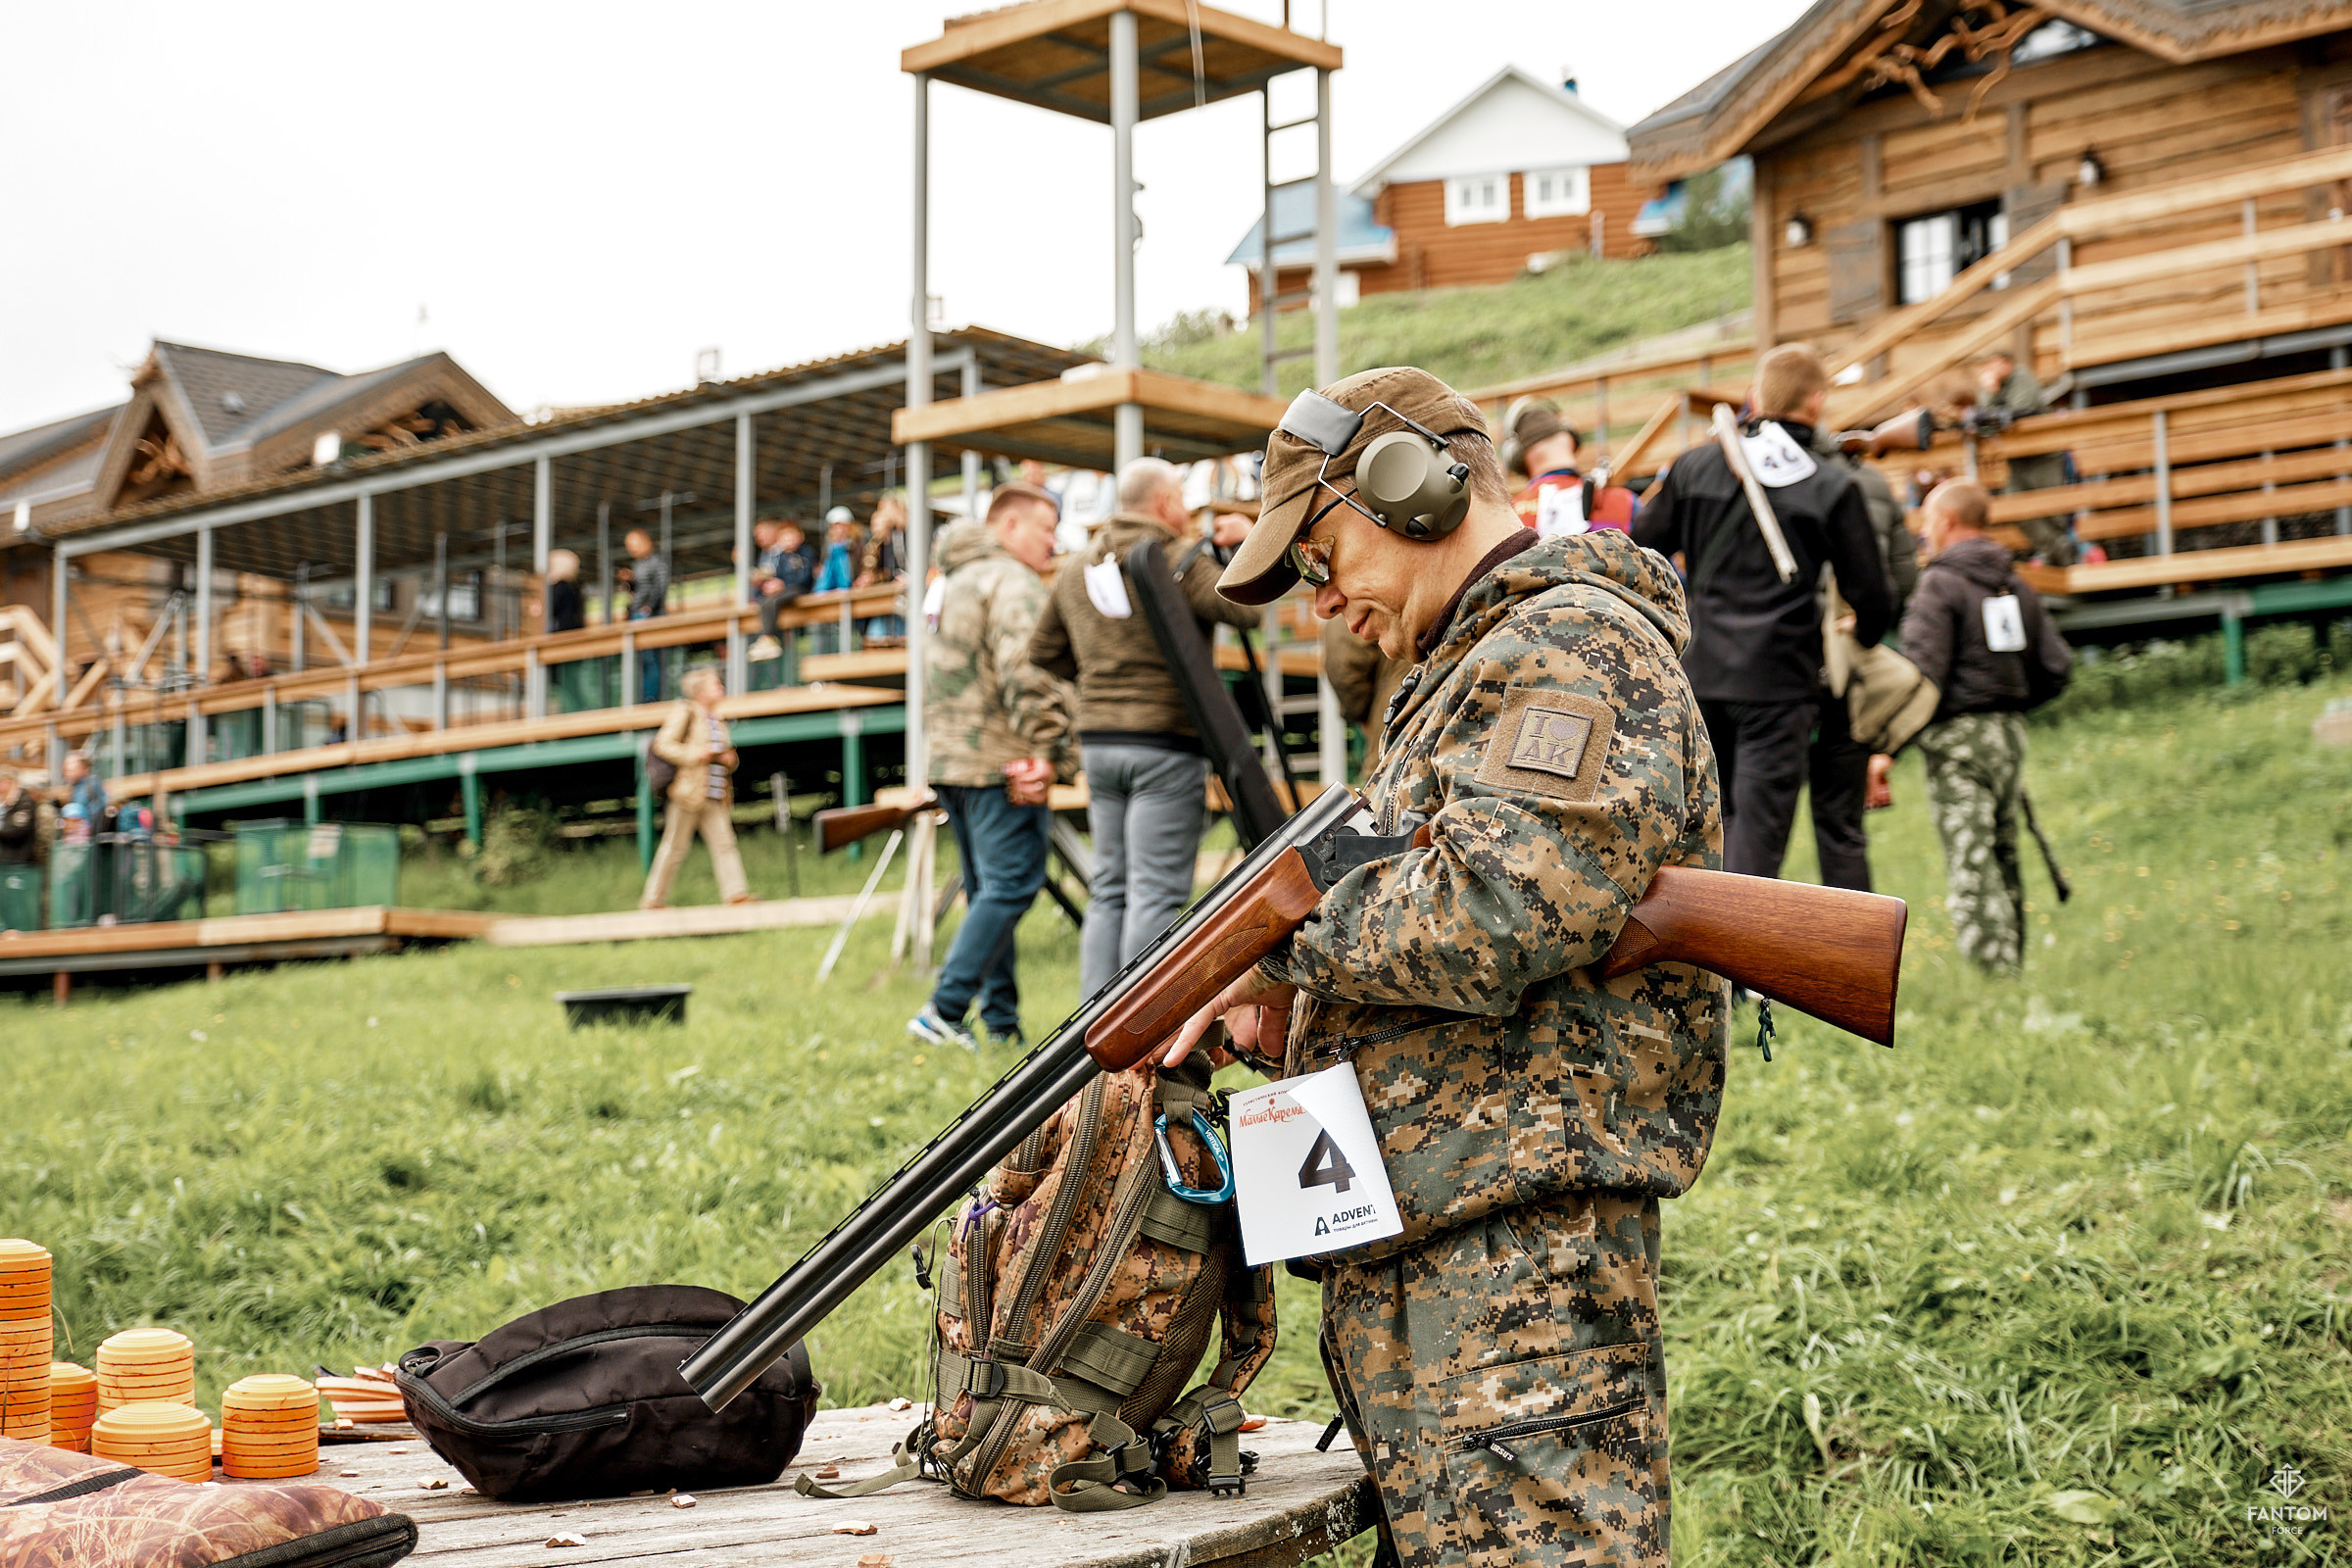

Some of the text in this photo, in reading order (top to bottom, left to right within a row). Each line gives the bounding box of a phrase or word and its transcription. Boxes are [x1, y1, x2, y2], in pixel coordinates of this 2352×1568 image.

[1529, 715, 1551, 739] I
[1515, 739, 1574, 767] AK
[1205, 1129, 1222, 1155] VERTICAL
[1298, 1127, 1356, 1194] 4
